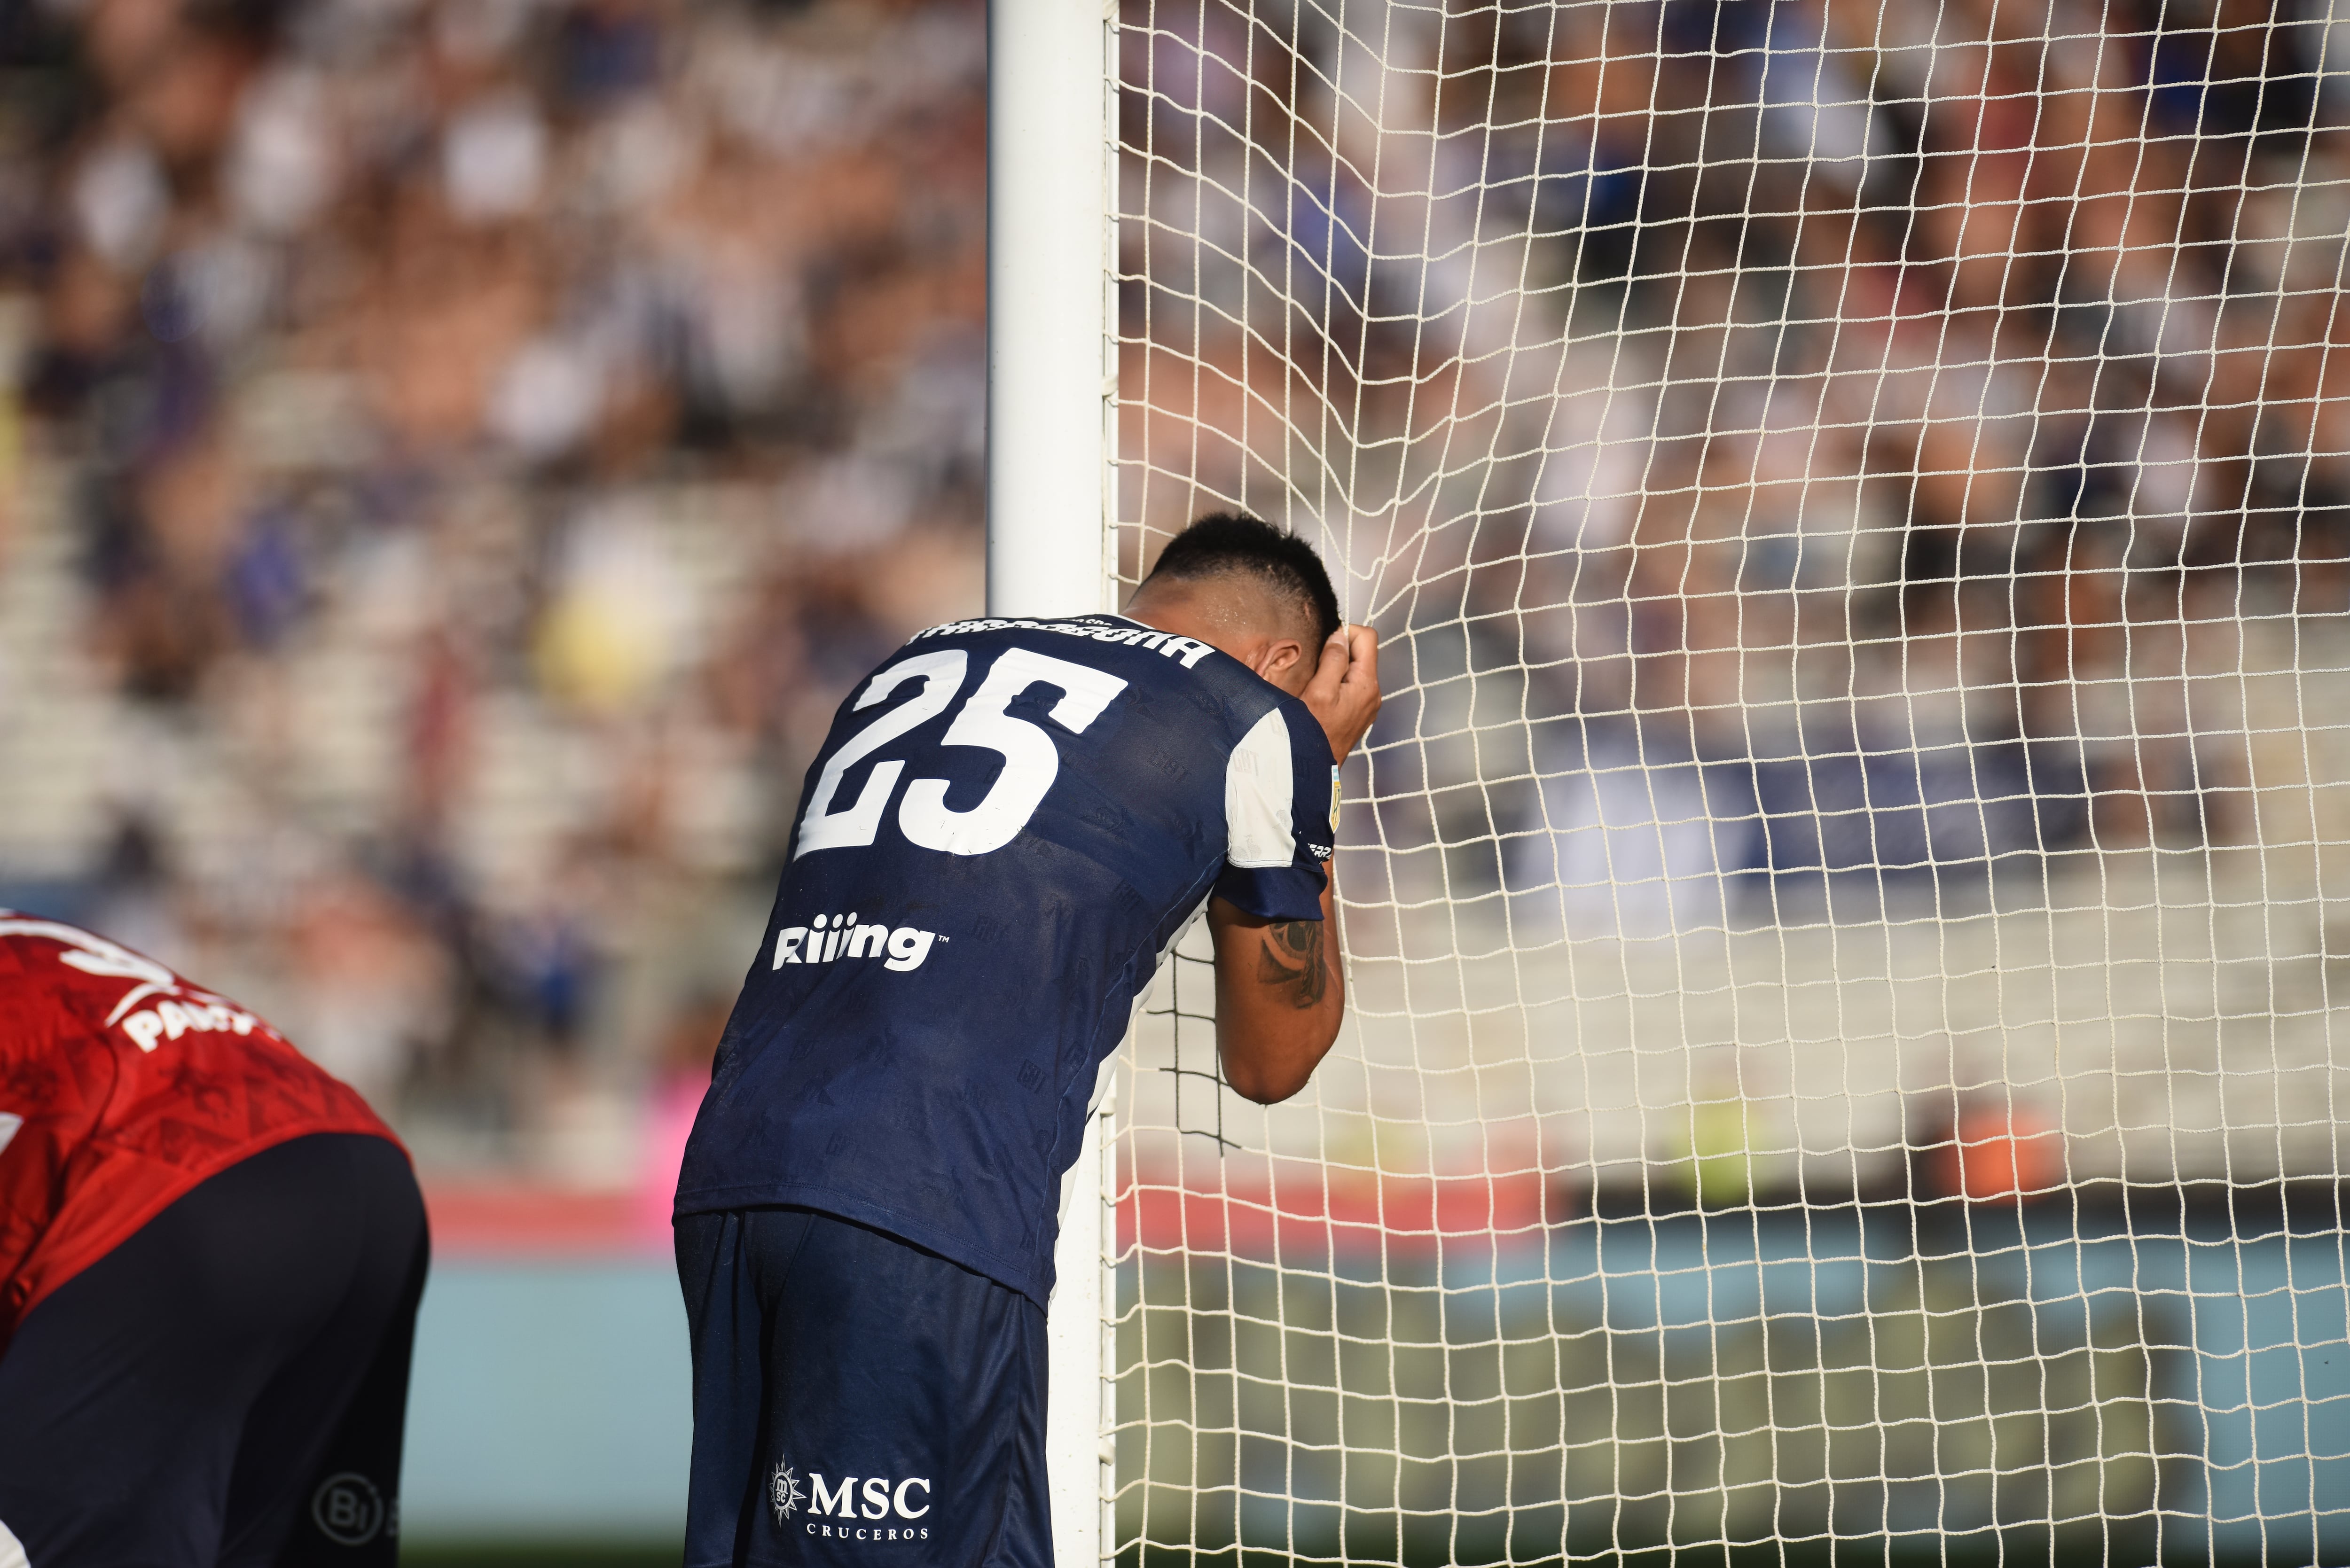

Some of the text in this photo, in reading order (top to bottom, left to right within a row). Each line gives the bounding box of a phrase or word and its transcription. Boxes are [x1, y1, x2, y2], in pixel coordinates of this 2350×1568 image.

[793, 647, 1128, 862] 25
[772, 912, 936, 971] Riiing
[807, 1473, 930, 1520] MSC
[807, 1523, 928, 1540] CRUCEROS
